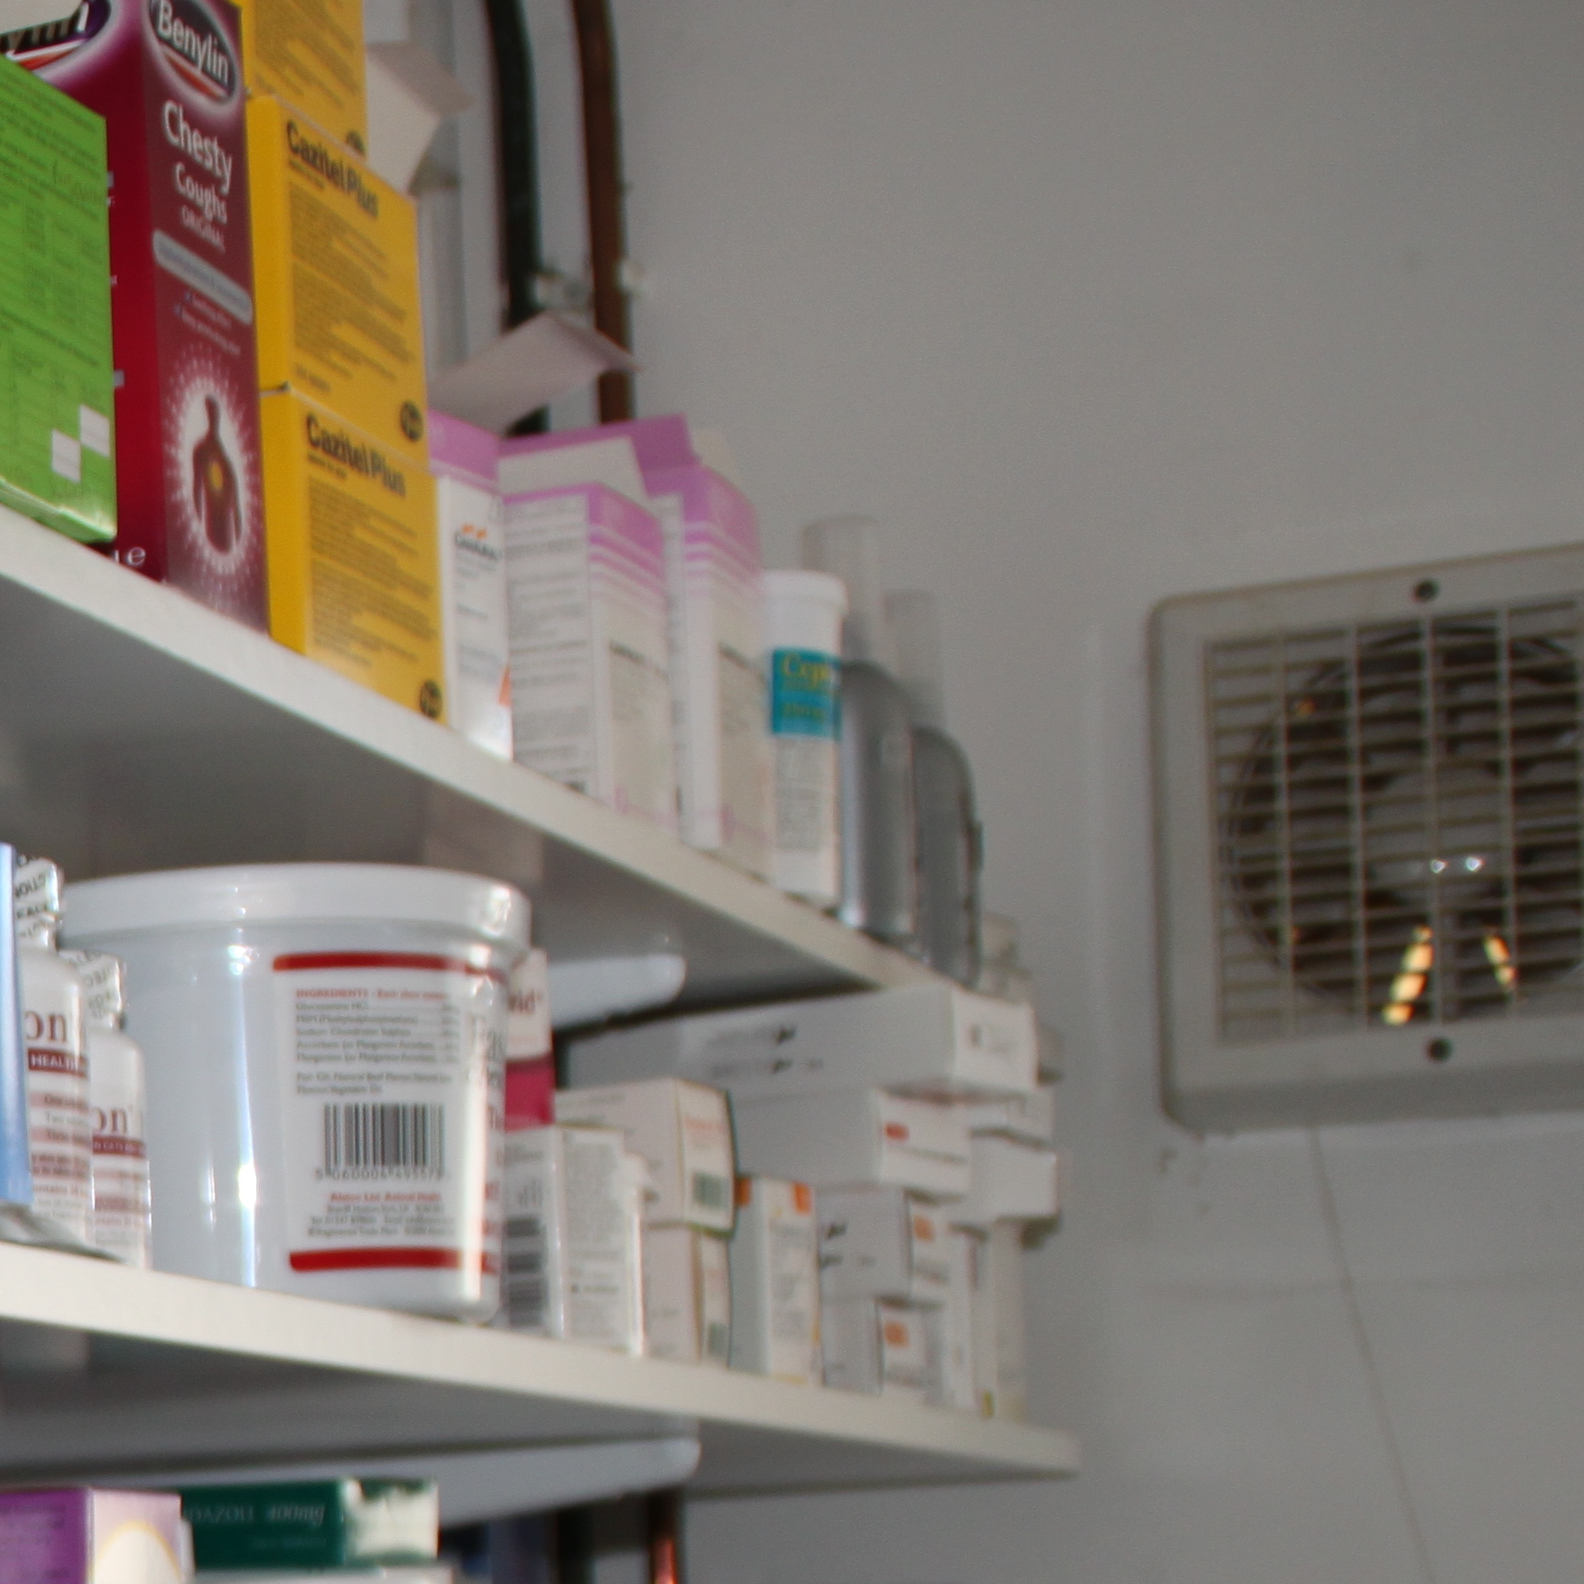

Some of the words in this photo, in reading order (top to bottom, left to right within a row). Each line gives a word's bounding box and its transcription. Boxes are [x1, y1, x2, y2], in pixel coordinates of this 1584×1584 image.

[157, 4, 231, 86] Benylin
[163, 99, 233, 193] Chesty
[174, 160, 229, 227] Coughs
